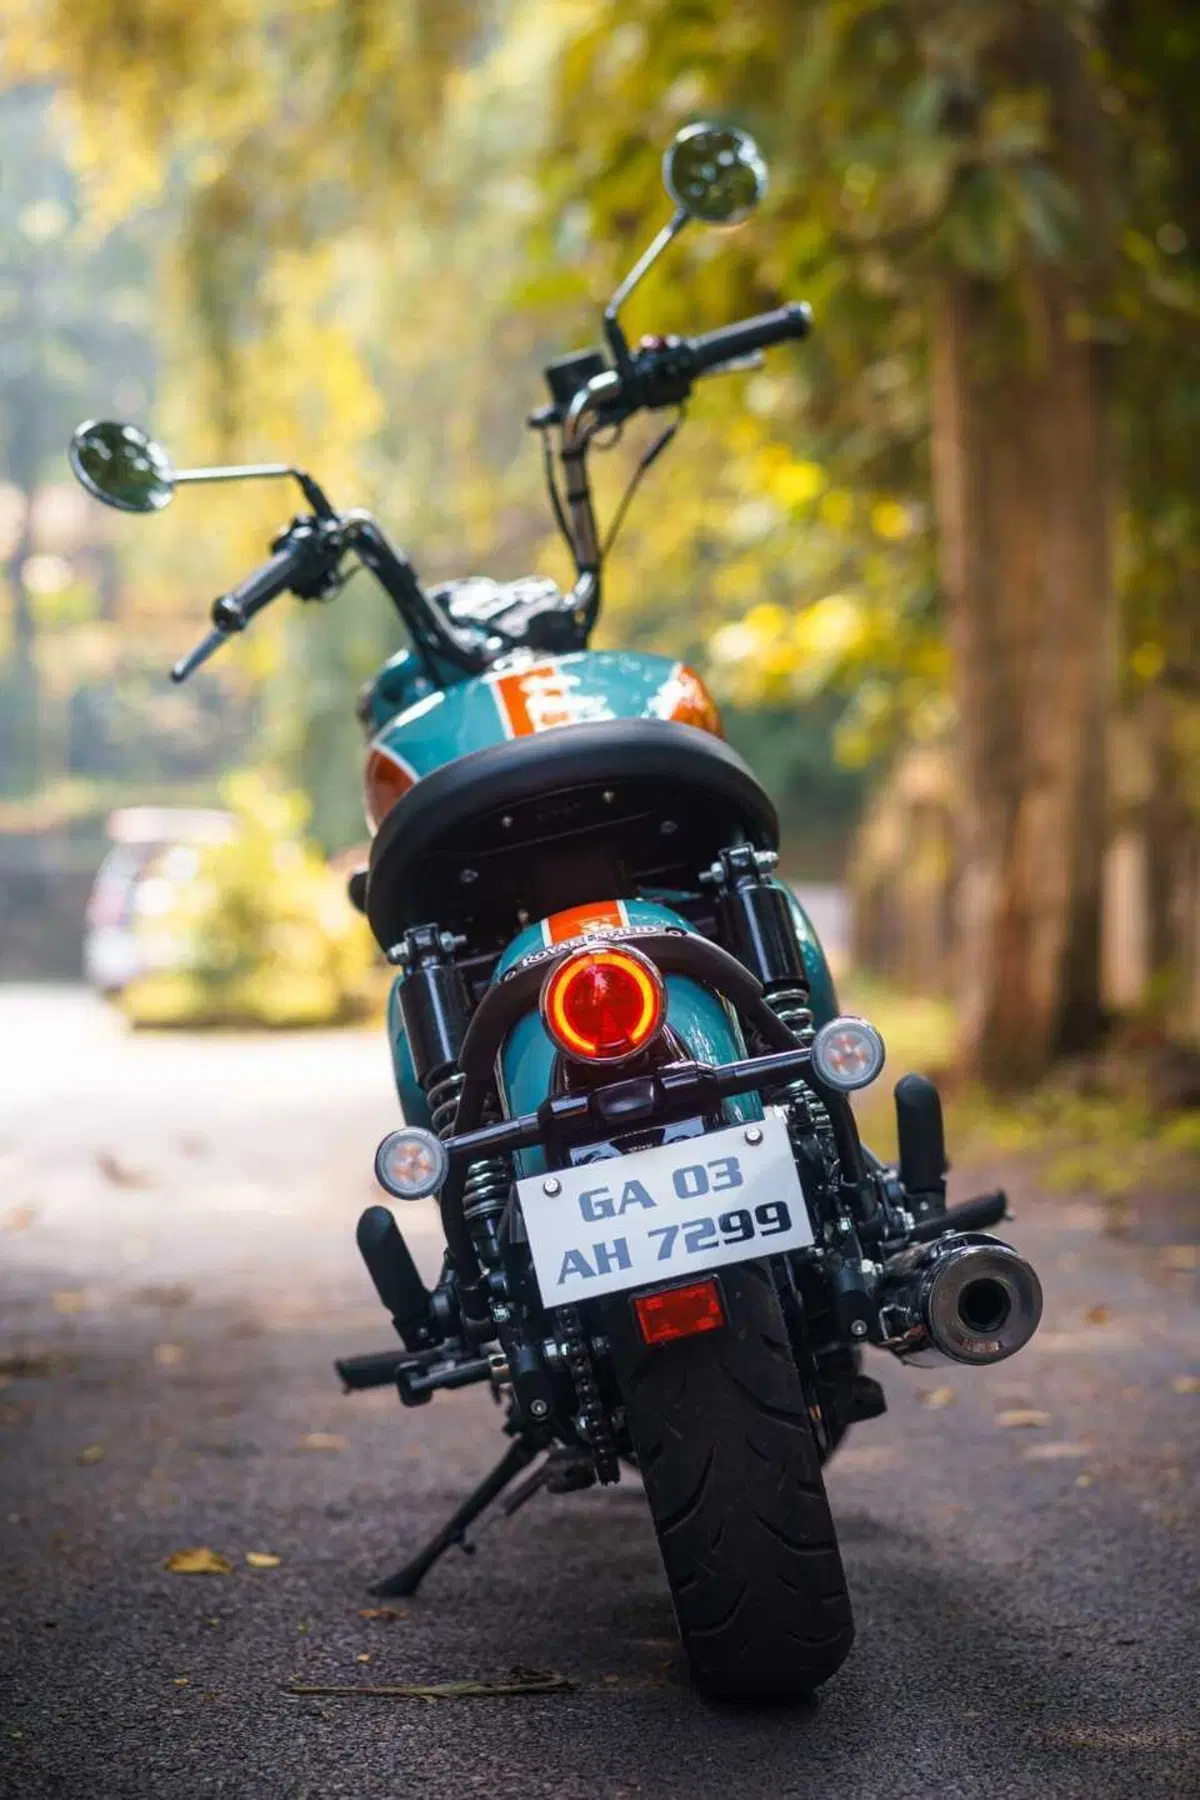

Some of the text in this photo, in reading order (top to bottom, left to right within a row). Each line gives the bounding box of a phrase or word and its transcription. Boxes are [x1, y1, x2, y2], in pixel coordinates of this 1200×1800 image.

[578, 1156, 744, 1222] GA 03
[557, 1200, 792, 1285] AH 7299
